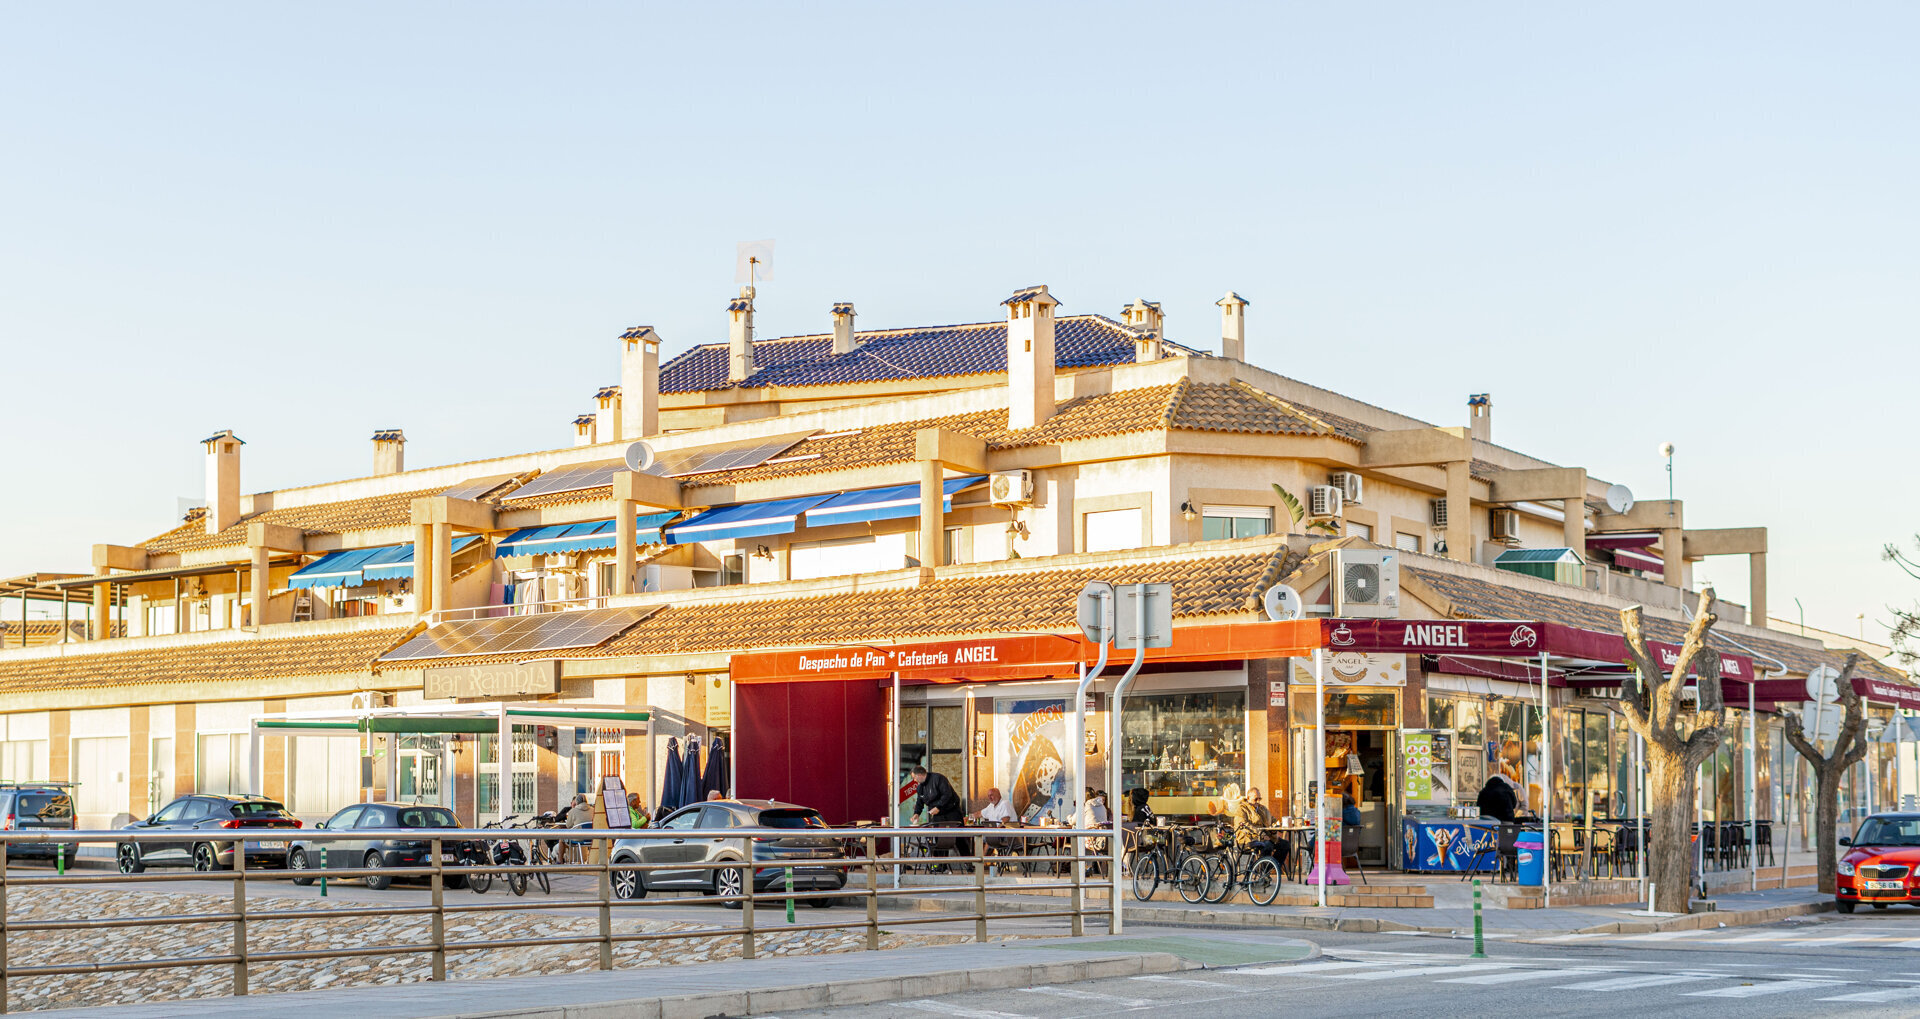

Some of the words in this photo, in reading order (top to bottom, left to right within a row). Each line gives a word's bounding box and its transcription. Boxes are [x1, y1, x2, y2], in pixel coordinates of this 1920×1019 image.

[1402, 624, 1469, 647] ANGEL
[799, 655, 848, 672] Despacho
[850, 653, 862, 667] de
[865, 652, 885, 667] Pan
[898, 651, 948, 667] Cafetería
[954, 646, 999, 664] ANGEL
[430, 674, 461, 696] Bar
[1008, 704, 1064, 757] MAXIBON
